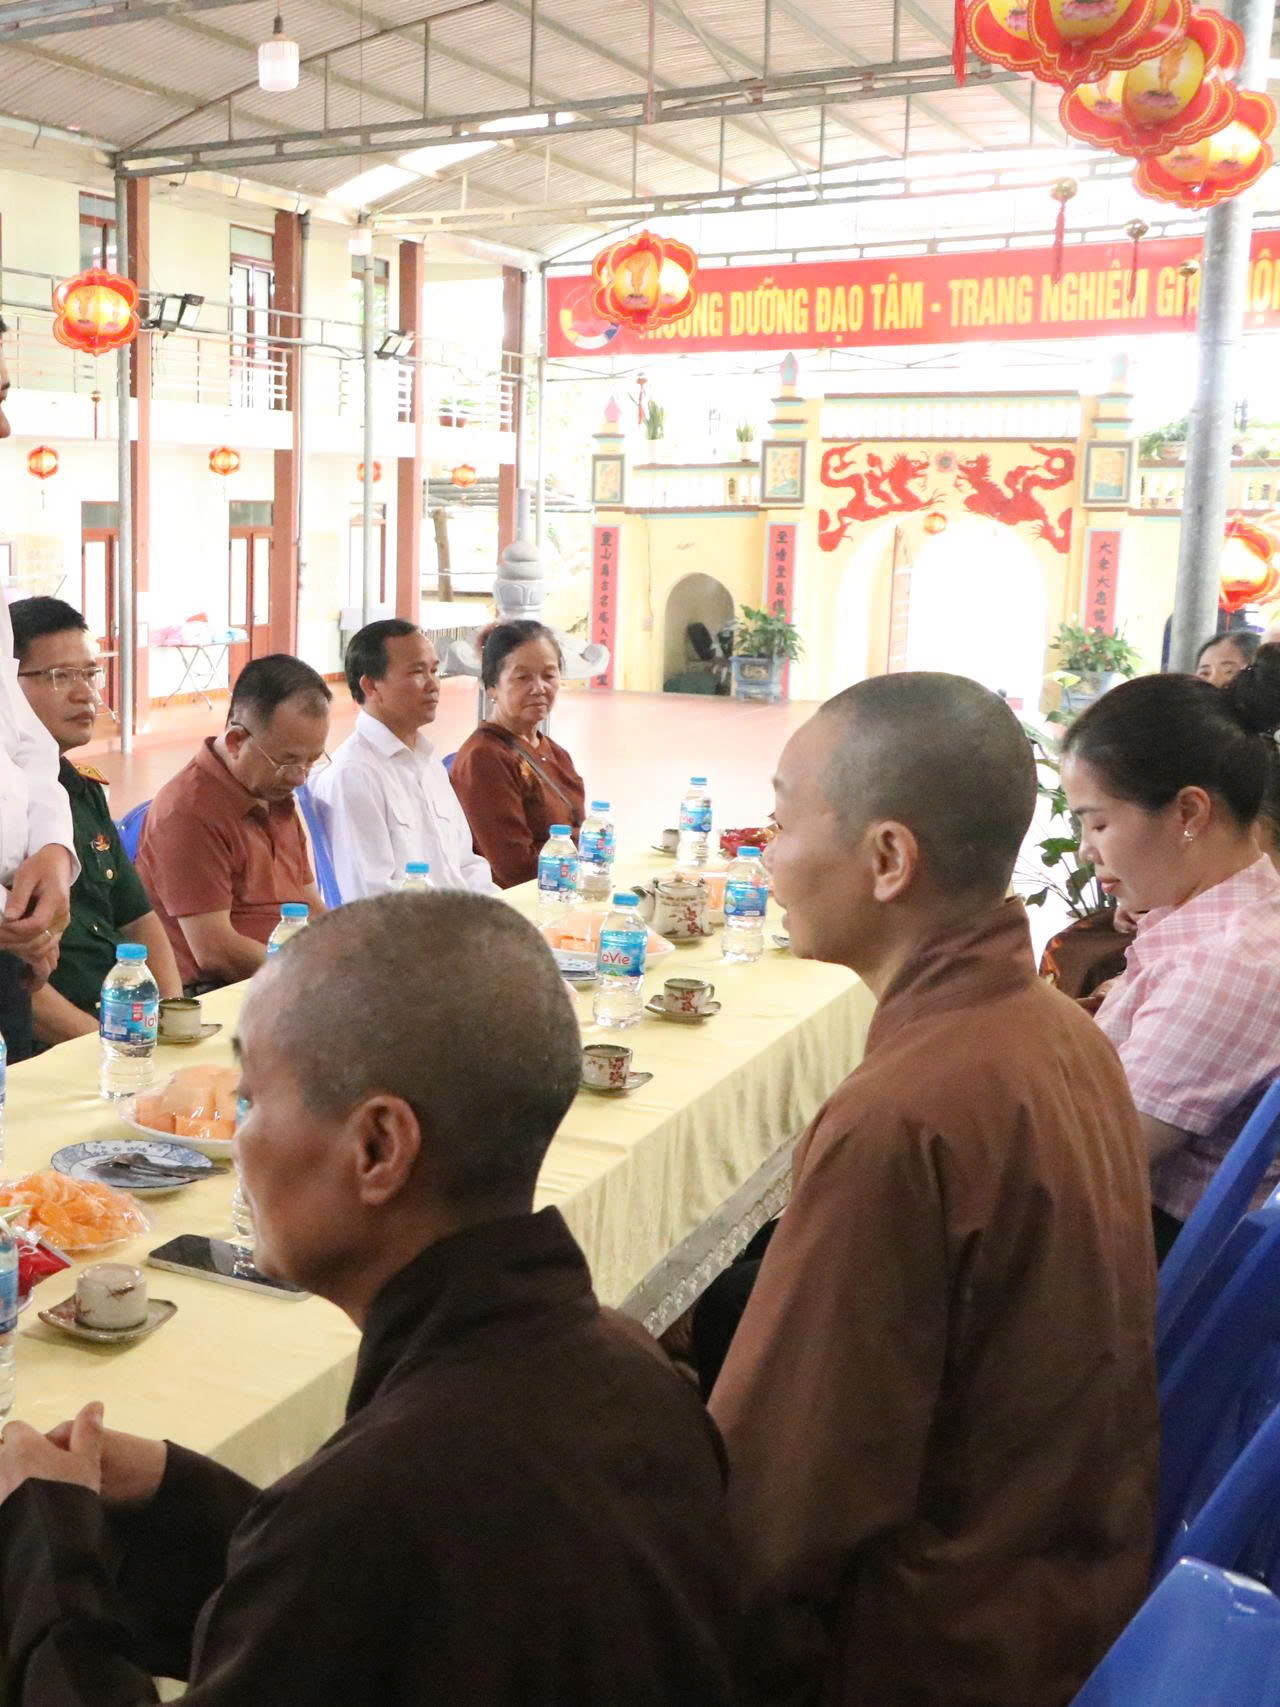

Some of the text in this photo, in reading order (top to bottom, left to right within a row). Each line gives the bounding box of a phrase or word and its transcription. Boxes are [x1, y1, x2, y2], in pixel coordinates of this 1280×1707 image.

[730, 277, 809, 336] DƯỠNG
[815, 285, 864, 342] ĐẠO
[871, 273, 924, 330] TÂM
[949, 274, 1034, 328] TRANG
[1040, 258, 1149, 321] NGHIÊM
[601, 950, 630, 965] aVie
